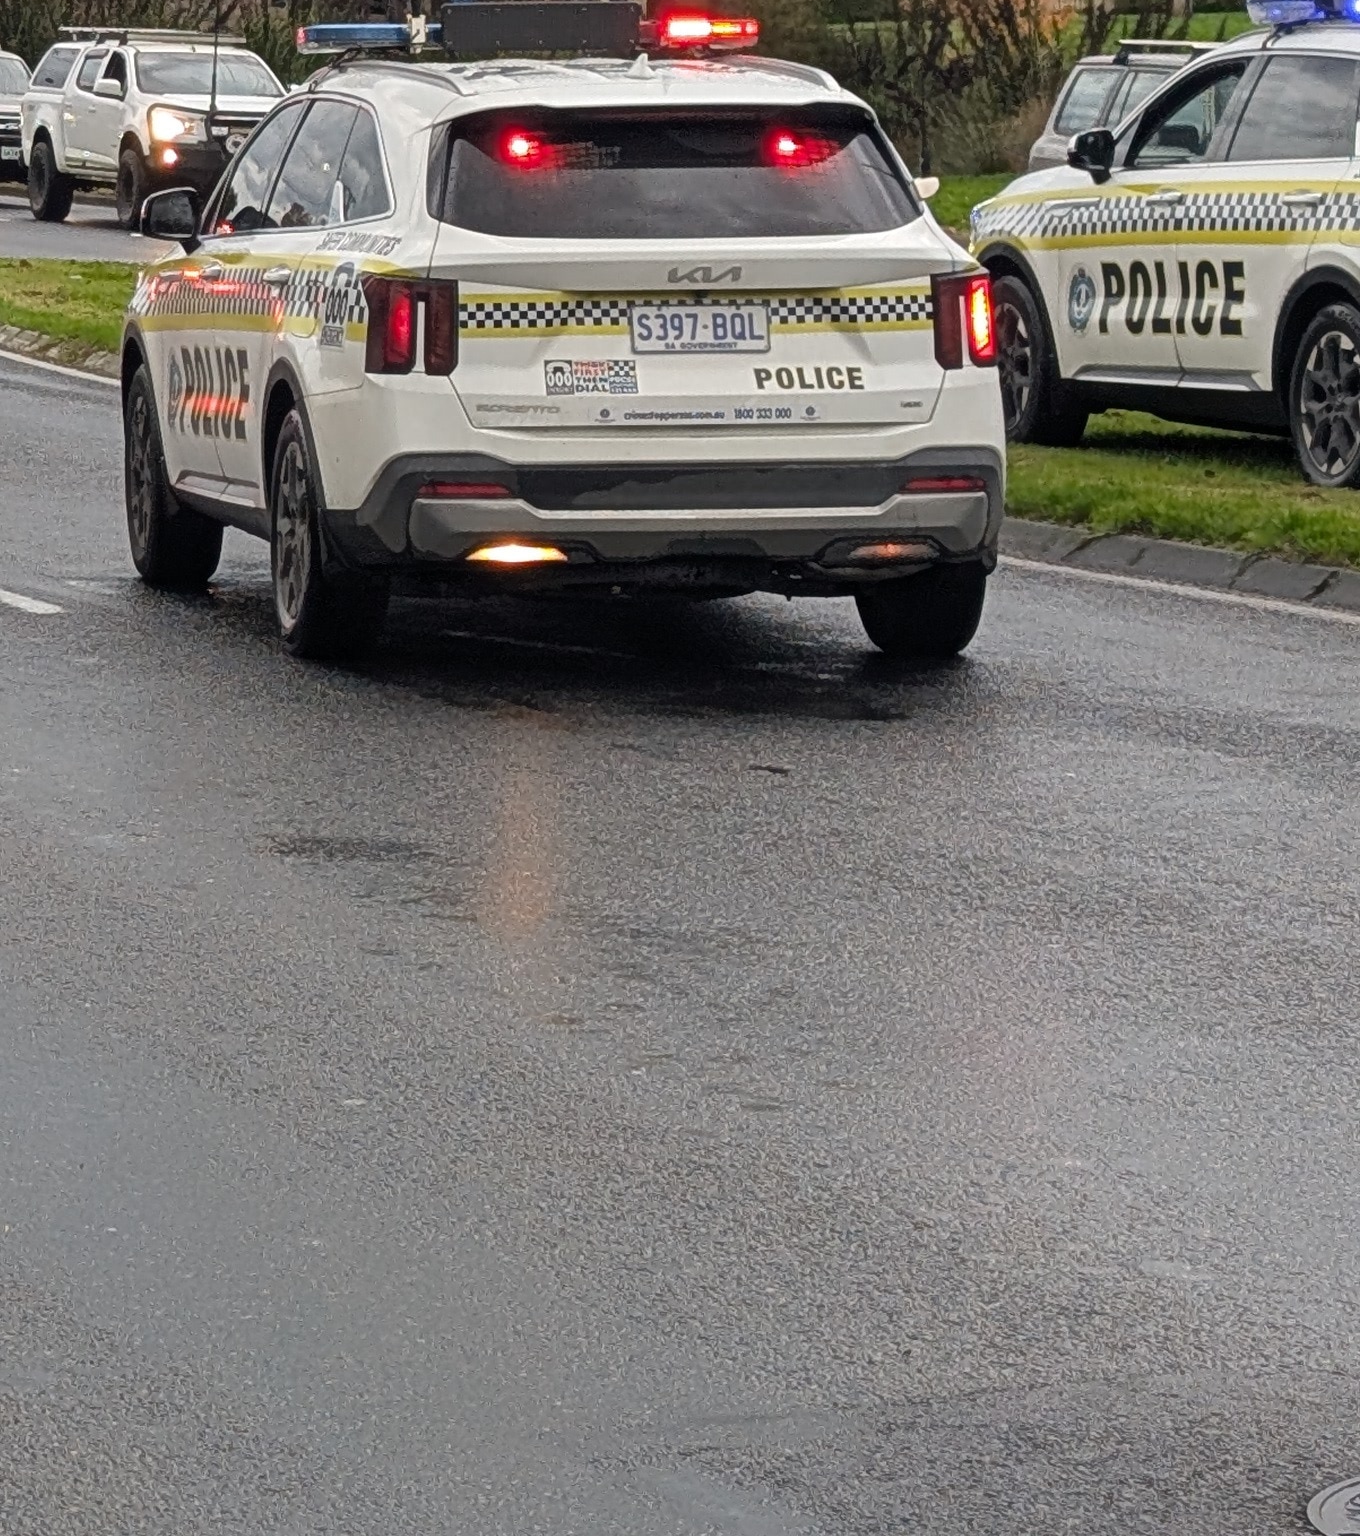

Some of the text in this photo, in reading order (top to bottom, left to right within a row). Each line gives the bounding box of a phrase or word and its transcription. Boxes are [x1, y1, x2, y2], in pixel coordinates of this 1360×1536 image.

[1098, 260, 1246, 336] POLICE
[325, 288, 348, 325] 000
[547, 372, 573, 387] 000
[574, 368, 606, 376] FIRST
[753, 366, 866, 391] POLICE
[576, 376, 608, 384] THEN
[180, 346, 251, 440] POLICE
[575, 384, 609, 393] DIAL
[734, 408, 754, 419] 1800
[756, 408, 773, 419] 333
[775, 408, 792, 419] 000
